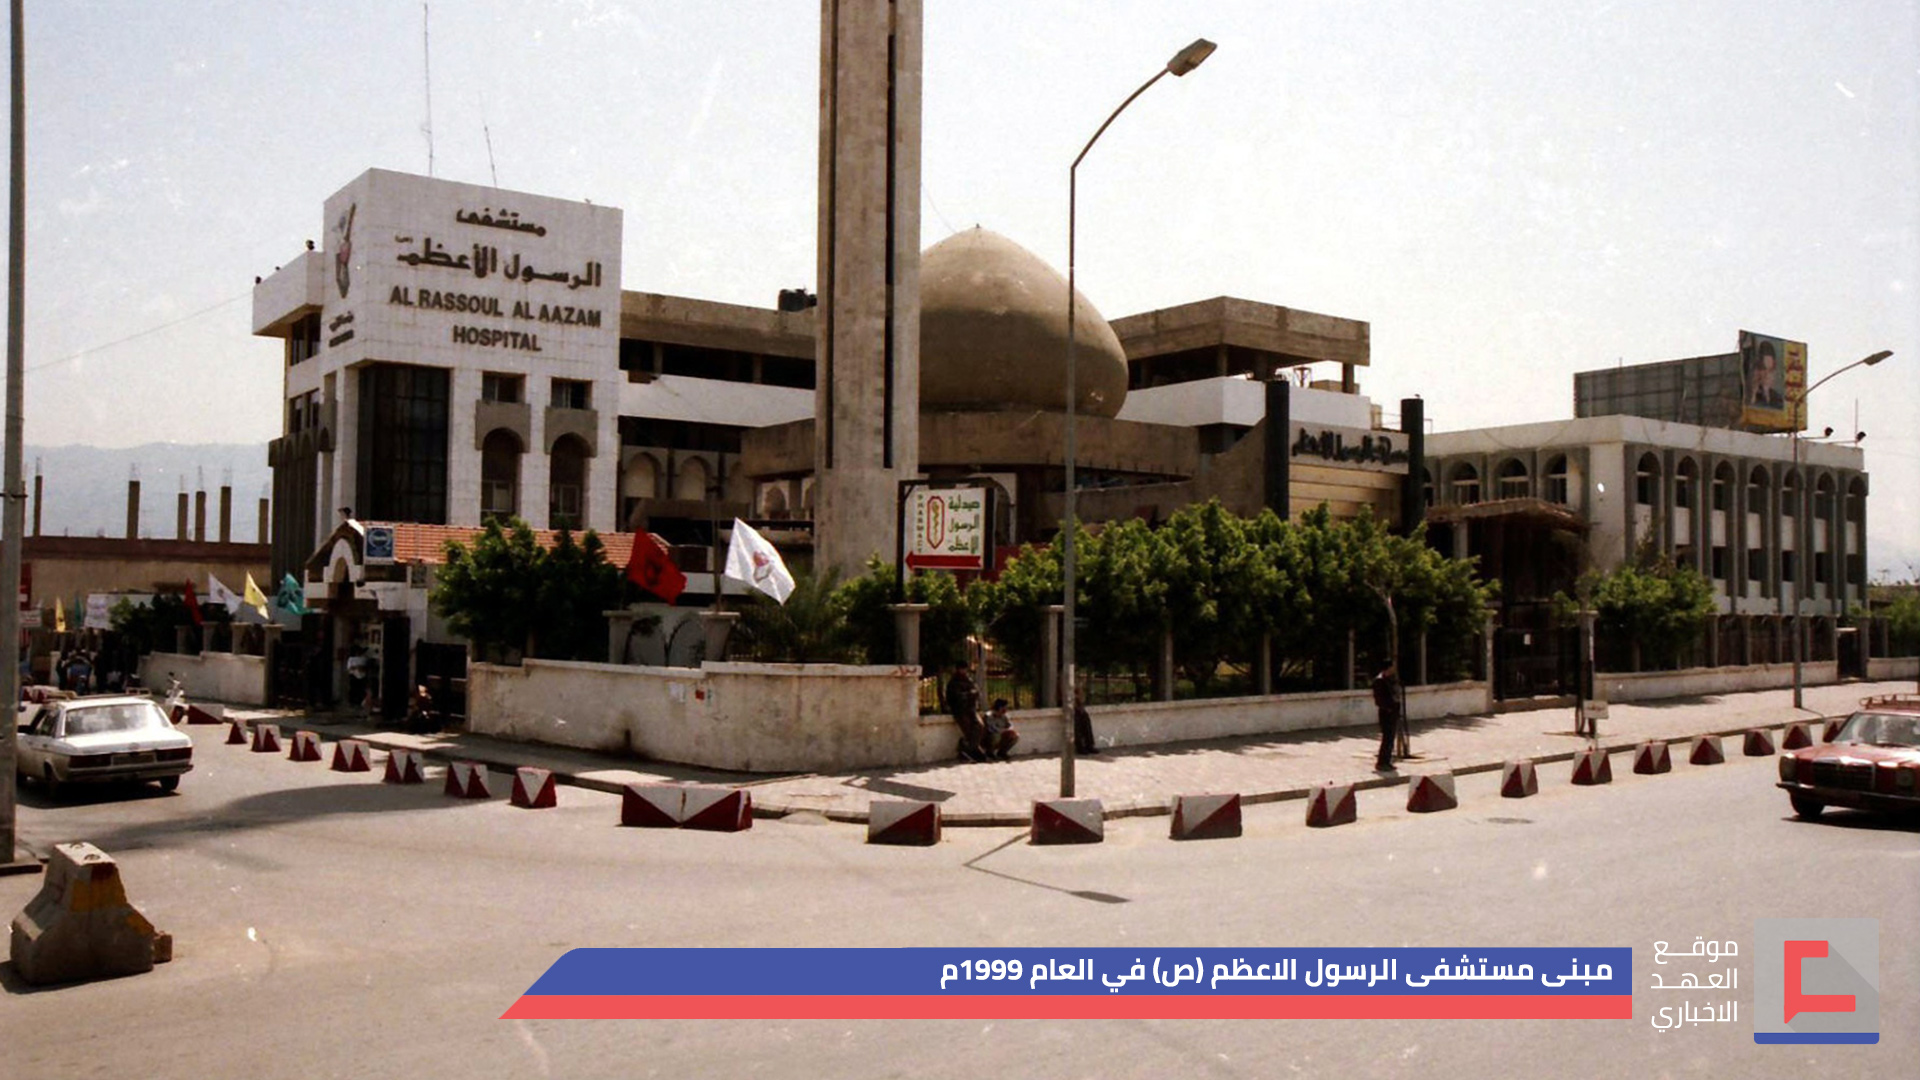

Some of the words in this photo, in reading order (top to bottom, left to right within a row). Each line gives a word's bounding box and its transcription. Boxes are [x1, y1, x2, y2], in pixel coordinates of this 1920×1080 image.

[456, 207, 546, 237] مستشفى
[503, 253, 602, 289] الرسول
[390, 285, 413, 305] AL
[419, 289, 504, 317] RASSOUL
[512, 301, 535, 319] AL
[538, 304, 602, 327] AAZAM
[452, 325, 542, 352] HOSPITAL
